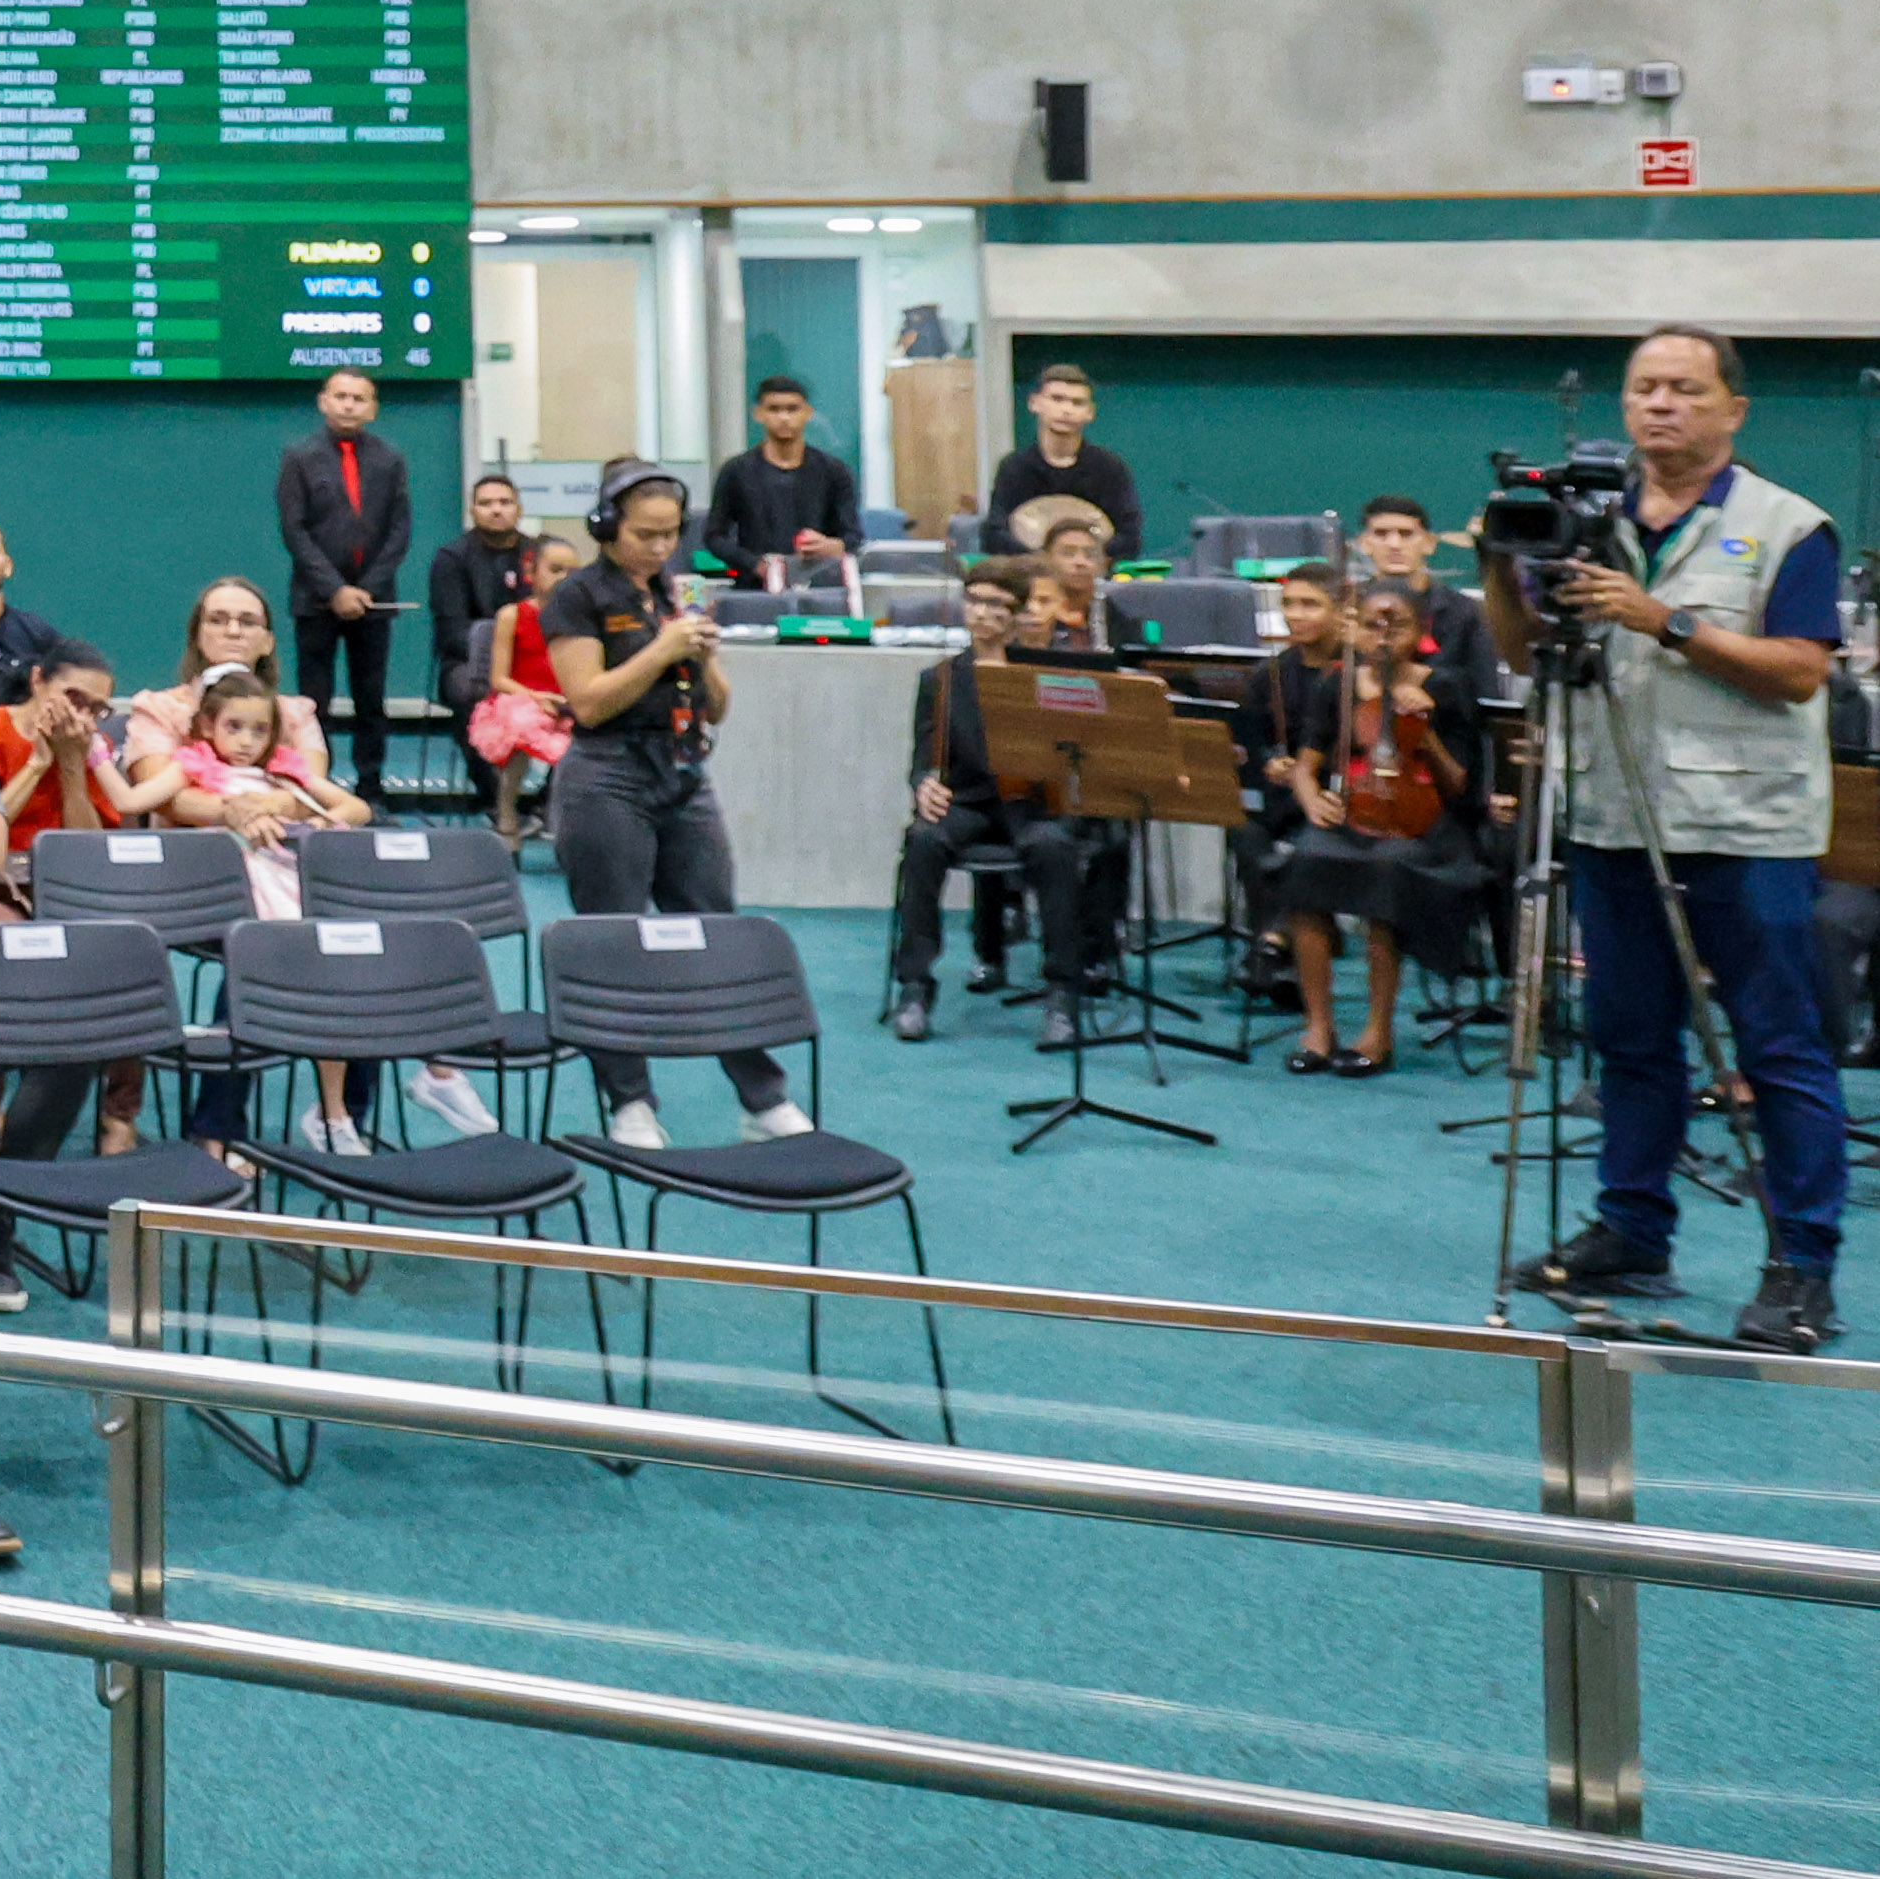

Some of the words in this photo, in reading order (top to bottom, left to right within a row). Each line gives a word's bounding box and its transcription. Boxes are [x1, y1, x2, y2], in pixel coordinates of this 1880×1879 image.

[289, 239, 383, 264] PLENÁRIO
[303, 276, 383, 298] VIRTUAL
[282, 311, 383, 334] PRESENTES
[290, 347, 383, 367] AUSENTES
